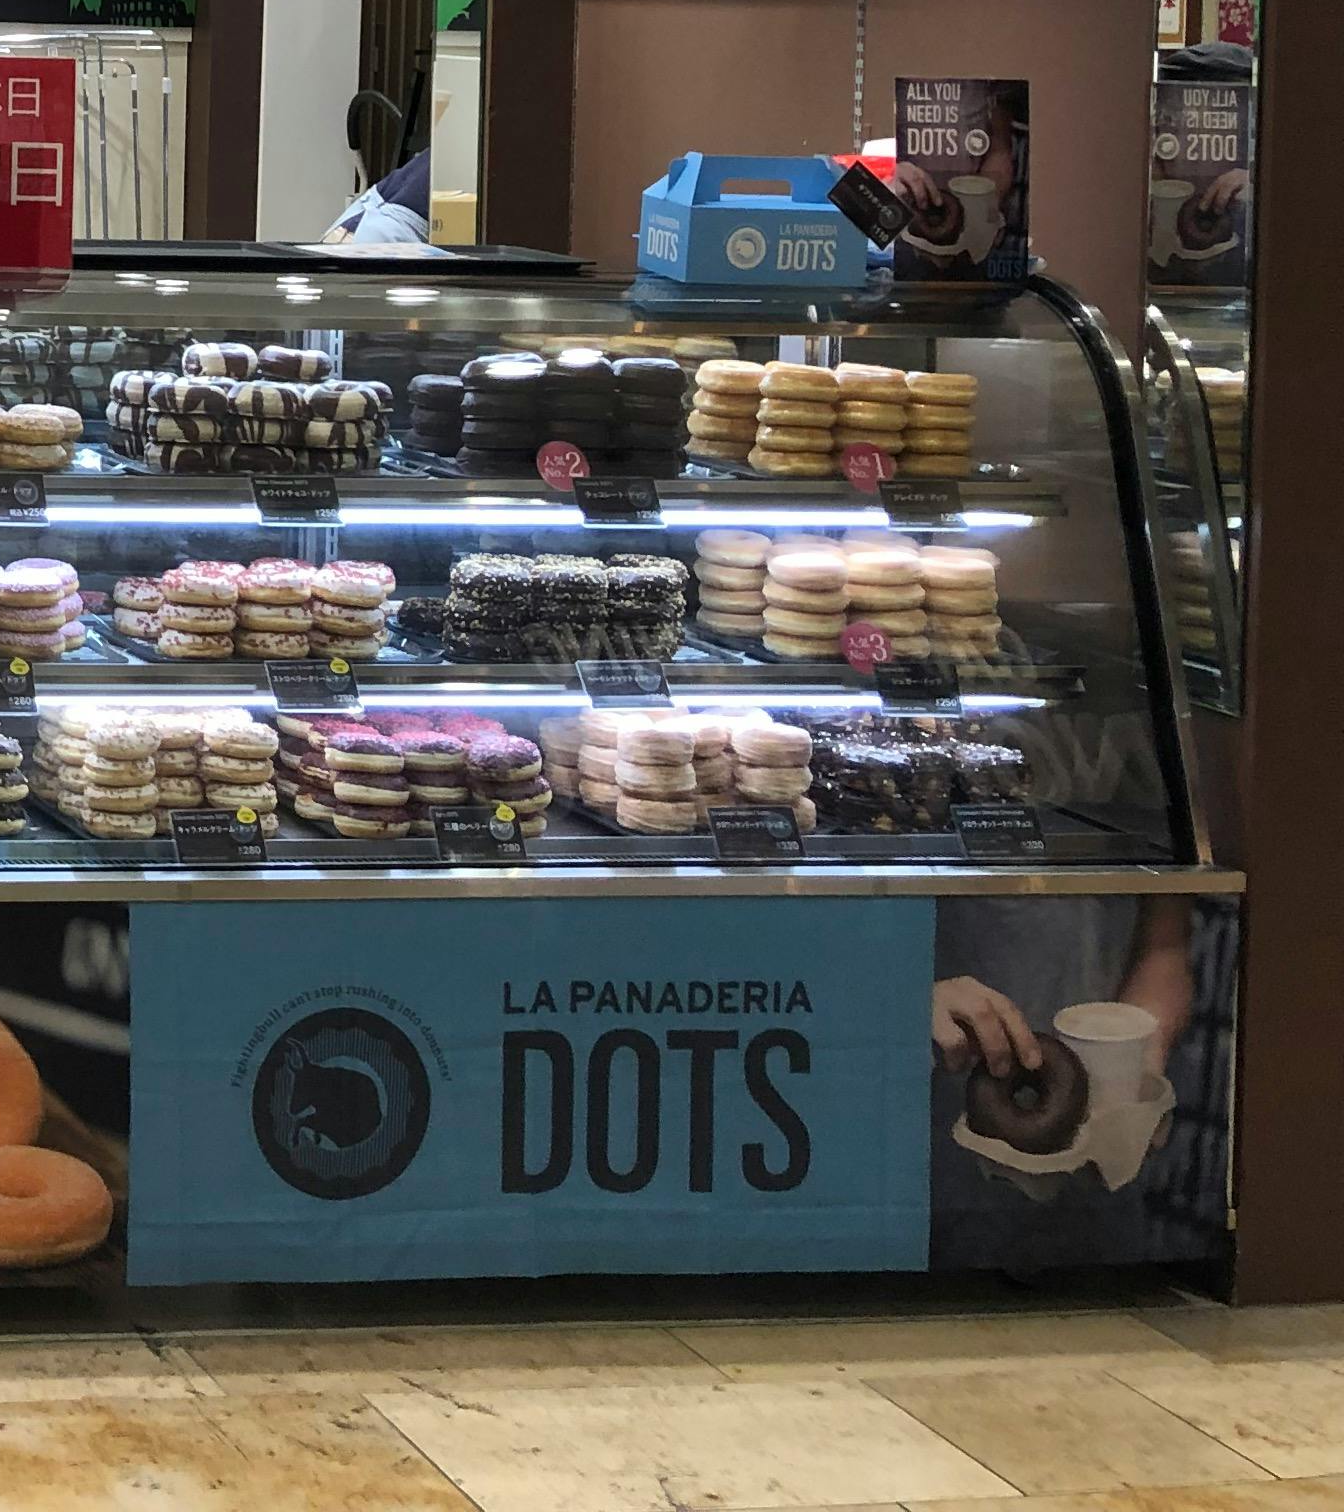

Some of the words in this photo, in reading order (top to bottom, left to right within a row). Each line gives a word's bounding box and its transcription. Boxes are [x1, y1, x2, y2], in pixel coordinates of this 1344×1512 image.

[906, 83, 932, 101] ALL
[934, 83, 961, 101] YOU
[906, 105, 941, 123] NEED
[945, 105, 959, 123] IS
[907, 128, 959, 156] DOTS
[646, 226, 679, 262] DOTS
[777, 239, 837, 272] DOTS
[565, 451, 584, 477] 2
[314, 985, 344, 998] stop
[346, 986, 398, 1010] rushing
[503, 980, 558, 1015] LA
[569, 980, 813, 1014] PANADERIA
[501, 1028, 812, 1195] DOTS
